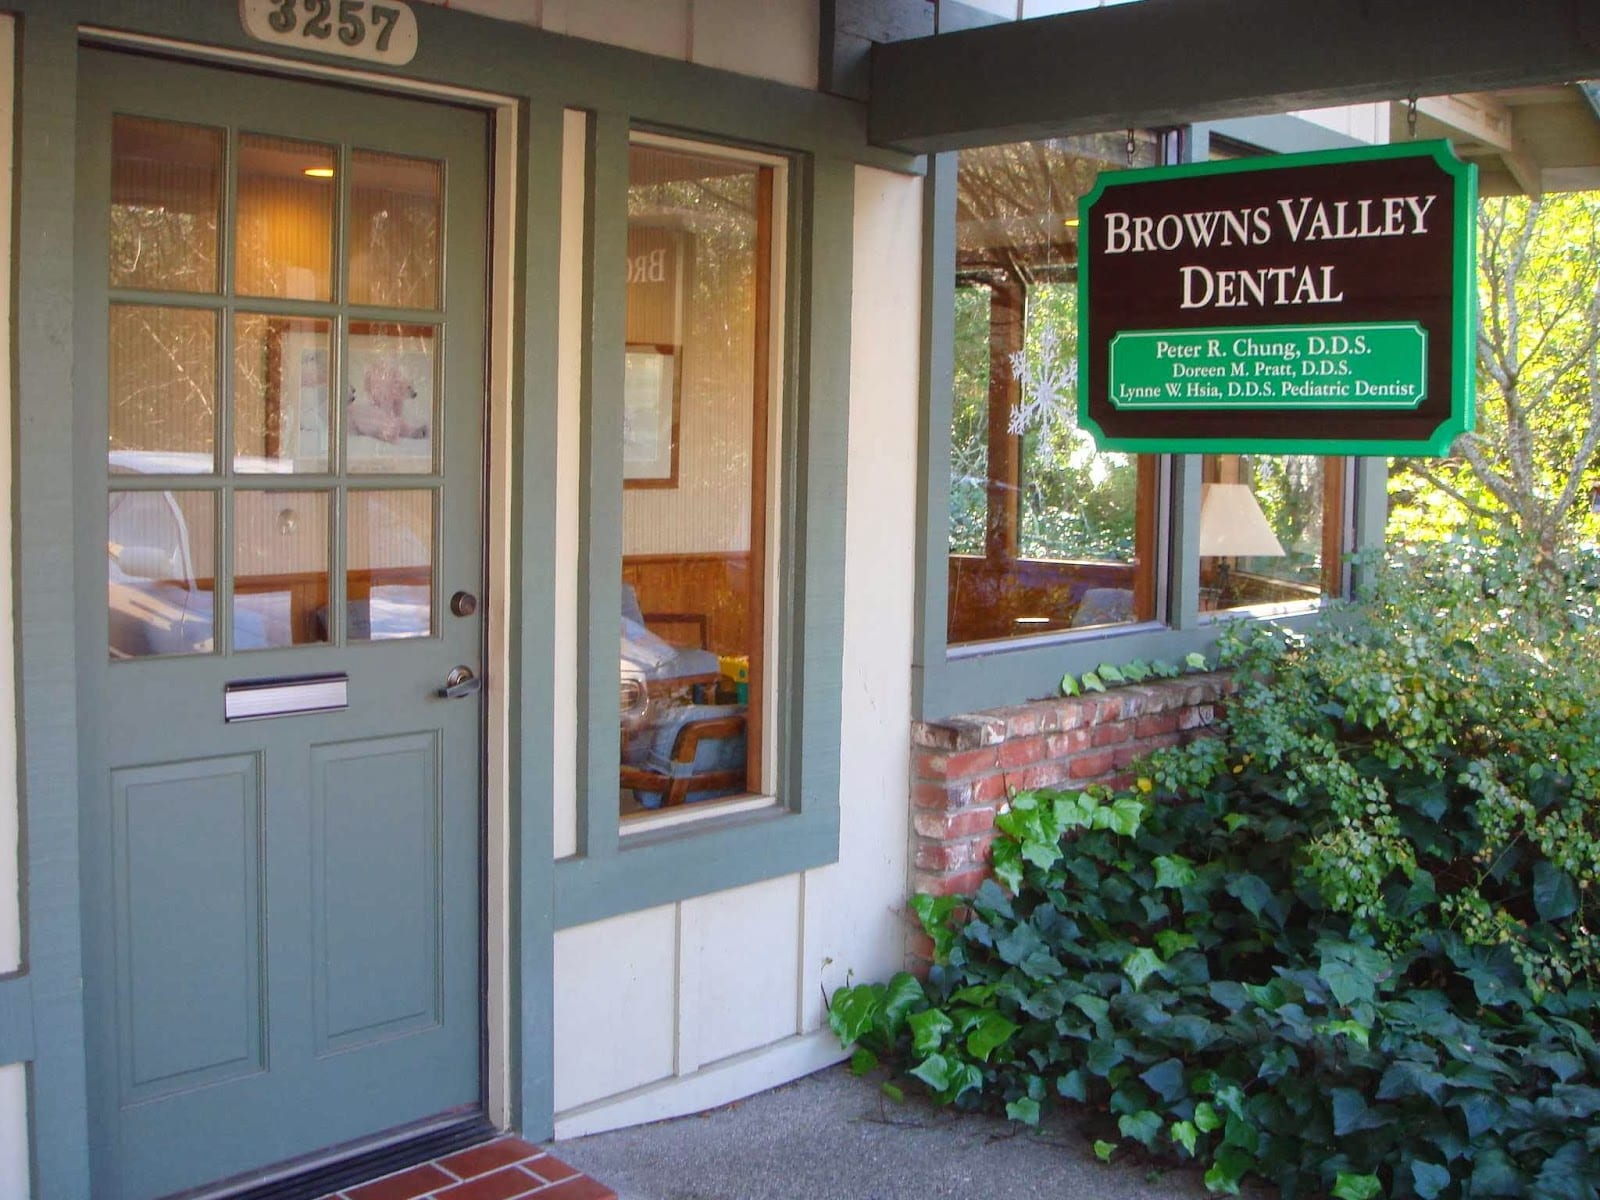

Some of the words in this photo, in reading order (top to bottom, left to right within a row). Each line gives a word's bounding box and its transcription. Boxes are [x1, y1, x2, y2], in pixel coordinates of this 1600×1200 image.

[268, 0, 400, 51] 3257
[1104, 206, 1271, 254] BROWNS
[1278, 194, 1436, 242] VALLEY
[1179, 265, 1343, 309] DENTAL
[1156, 341, 1202, 358] Peter
[1207, 339, 1226, 357] R.
[1233, 338, 1301, 360] Chung,
[1307, 335, 1371, 355] D.D.S.
[1173, 362, 1226, 378] Doreen
[1230, 362, 1249, 377] M.
[1255, 361, 1297, 378] Pratt,
[1301, 360, 1352, 376] D.D.S.
[1119, 383, 1161, 401] Lynne
[1165, 383, 1182, 398] W.
[1187, 382, 1223, 399] Hsia,
[1228, 381, 1276, 397] D.D.S.
[1281, 381, 1350, 396] Pediatric
[1355, 380, 1415, 396] Dentist
